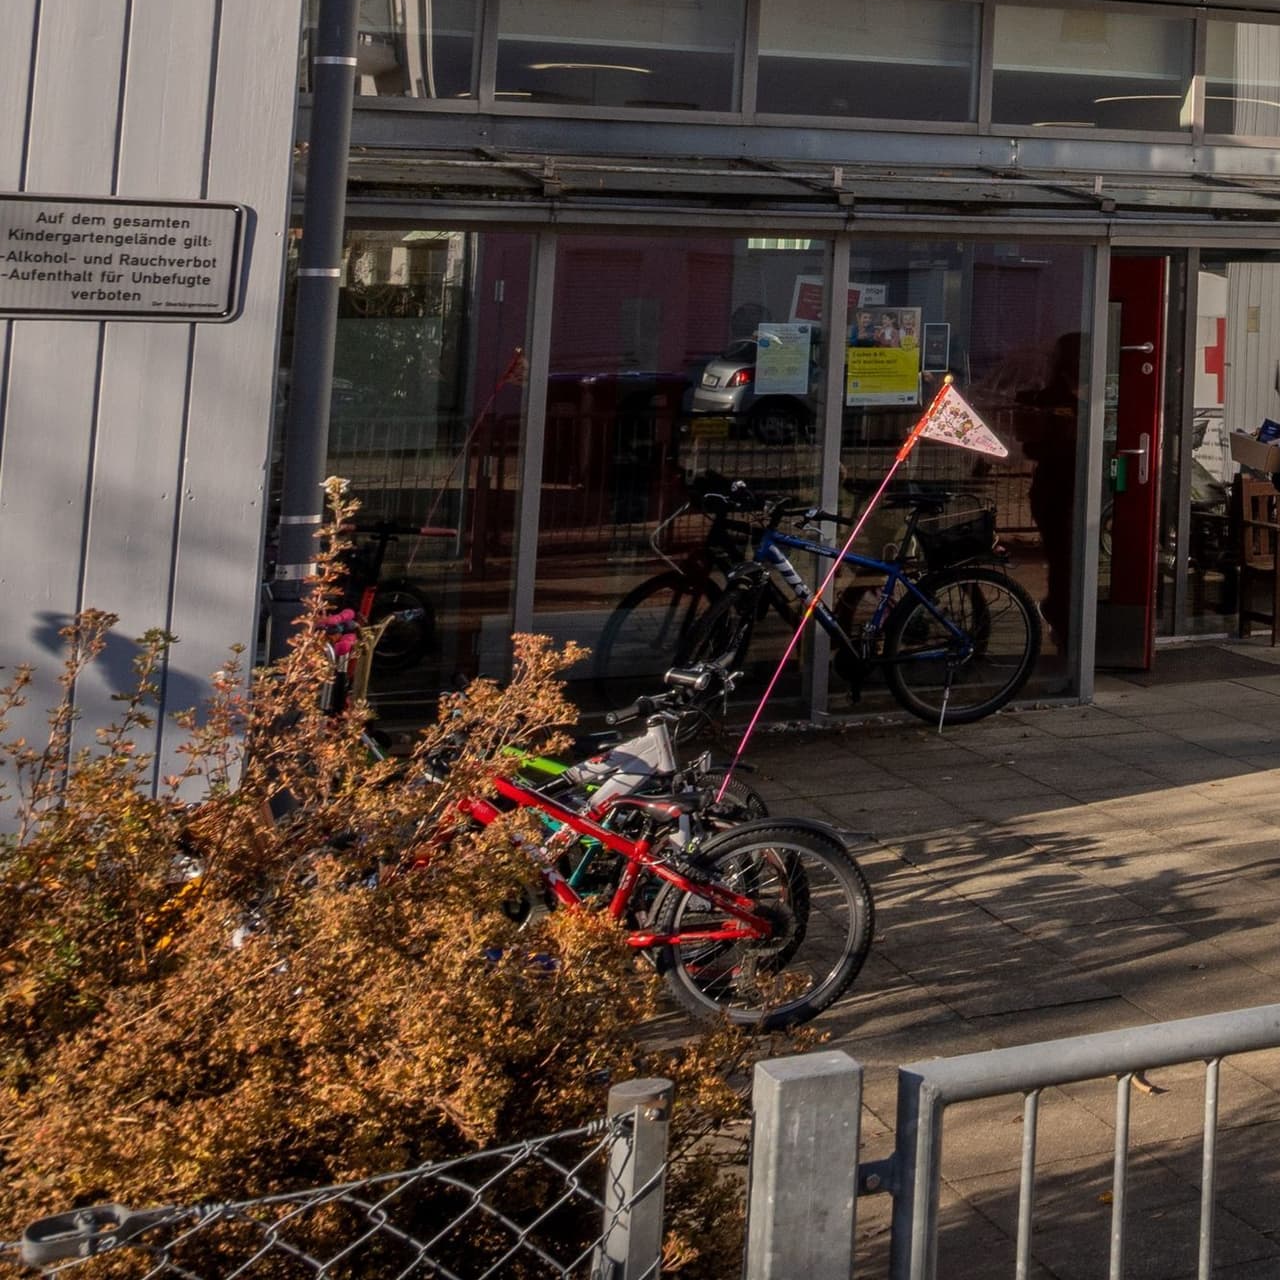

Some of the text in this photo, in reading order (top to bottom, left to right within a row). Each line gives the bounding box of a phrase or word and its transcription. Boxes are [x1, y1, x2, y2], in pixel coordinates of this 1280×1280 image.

[36, 211, 190, 229] Auf dem gesamten
[8, 228, 212, 249] Kindergartengelände gilt:
[83, 253, 112, 265] und
[120, 253, 216, 268] Rauchverbot
[101, 271, 124, 283] für
[132, 271, 211, 288] Unbefugte
[71, 289, 141, 301] verboten
